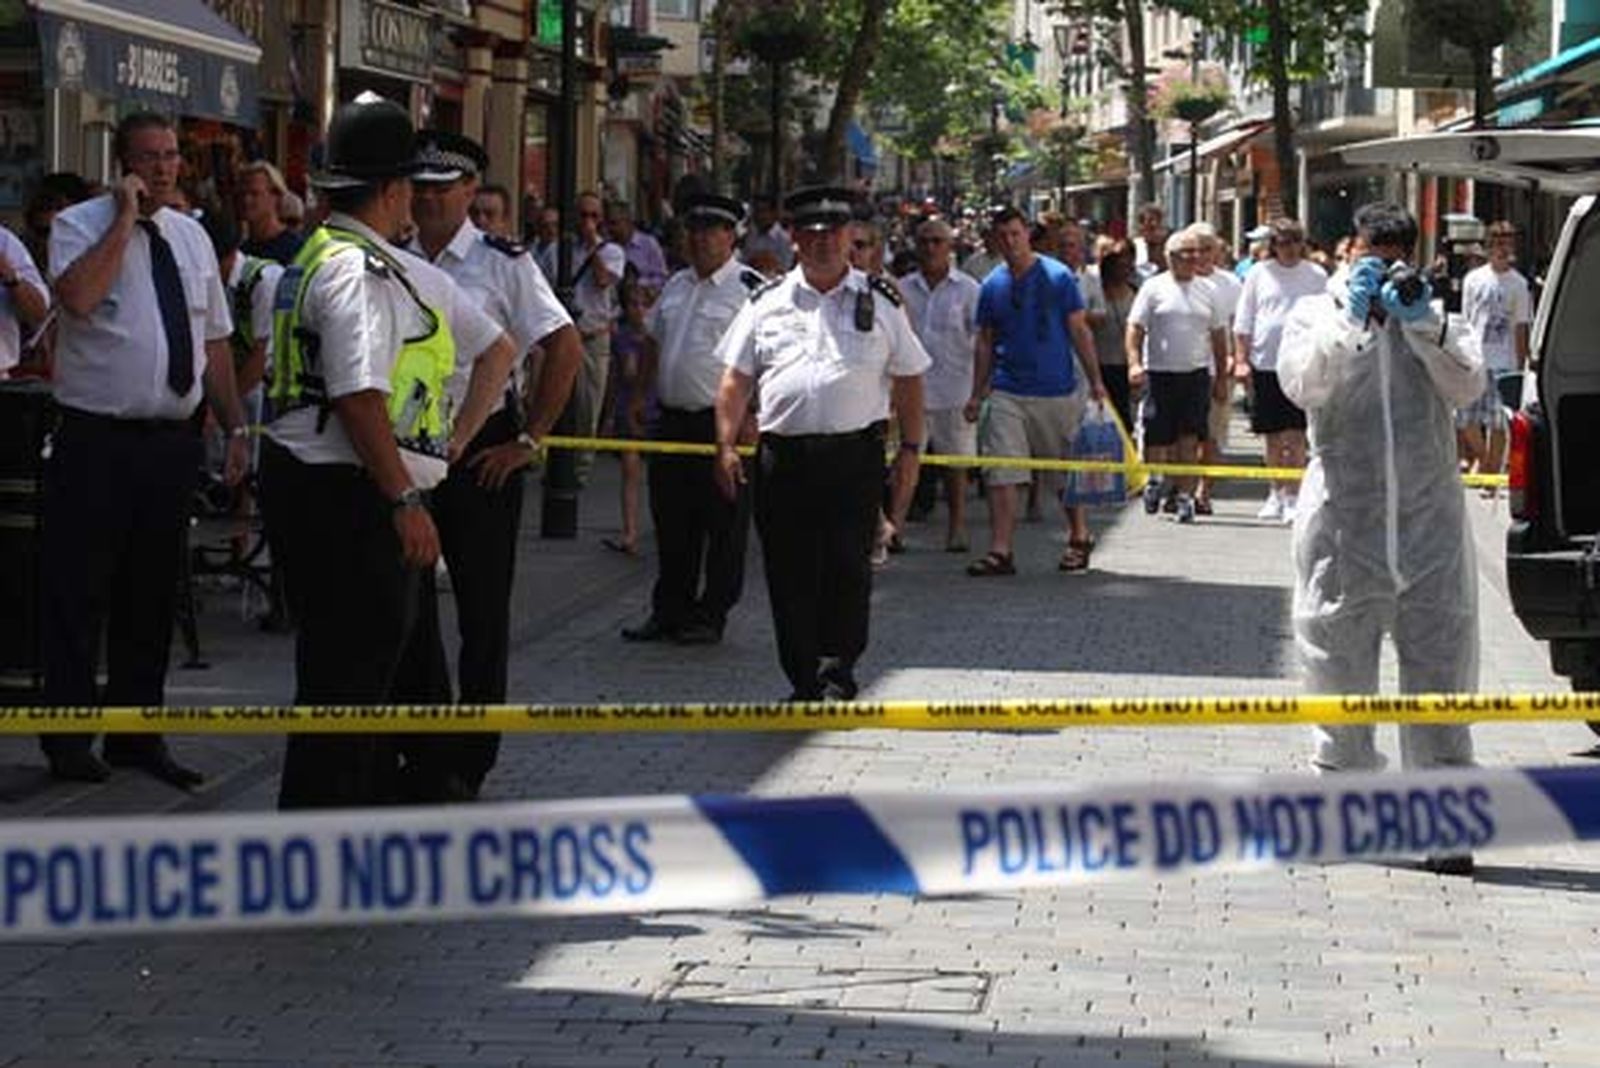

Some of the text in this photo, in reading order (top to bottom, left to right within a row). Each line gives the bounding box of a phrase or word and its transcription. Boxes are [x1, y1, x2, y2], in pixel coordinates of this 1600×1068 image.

[4, 821, 655, 926] POLICE DO NOT CROSS
[961, 785, 1496, 876] POLICE DO NOT CROSS
